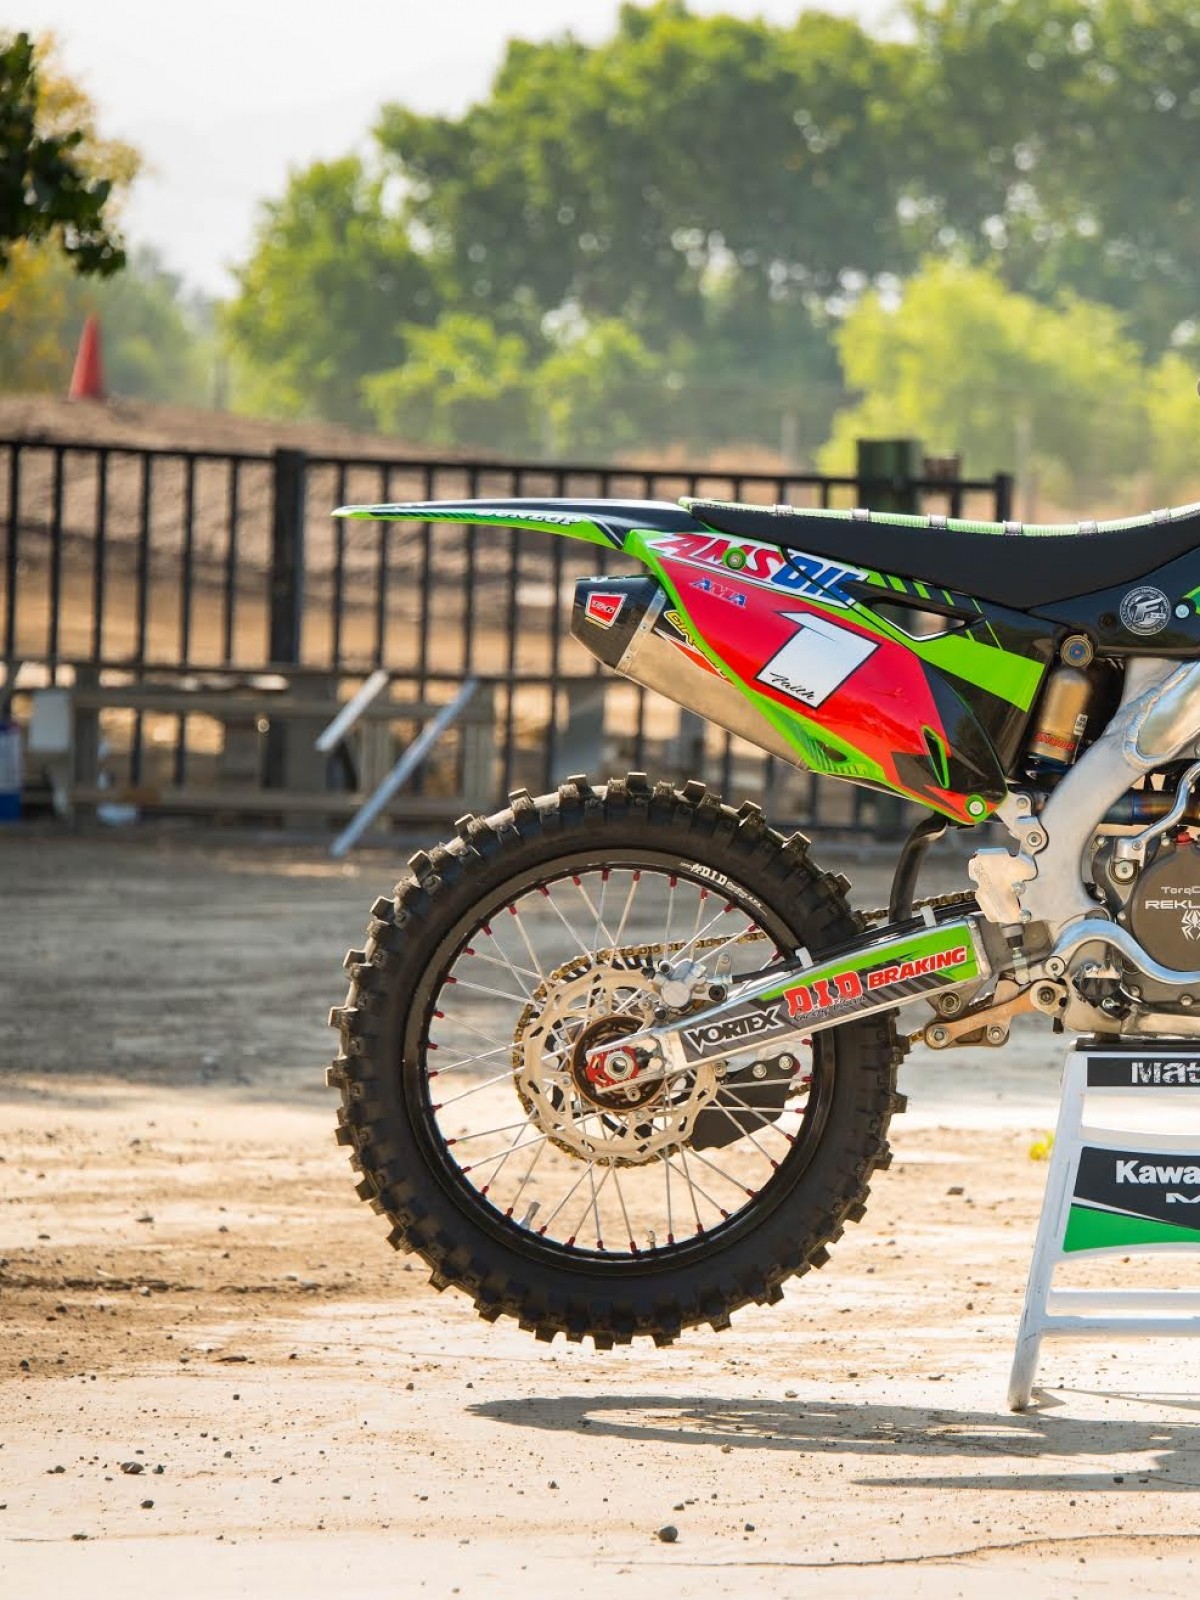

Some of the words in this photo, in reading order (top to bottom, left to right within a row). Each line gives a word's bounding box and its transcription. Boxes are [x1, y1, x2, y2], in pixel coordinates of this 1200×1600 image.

[756, 611, 881, 708] 1
[867, 947, 968, 991] BRAKING
[685, 1005, 785, 1054] VORTEX
